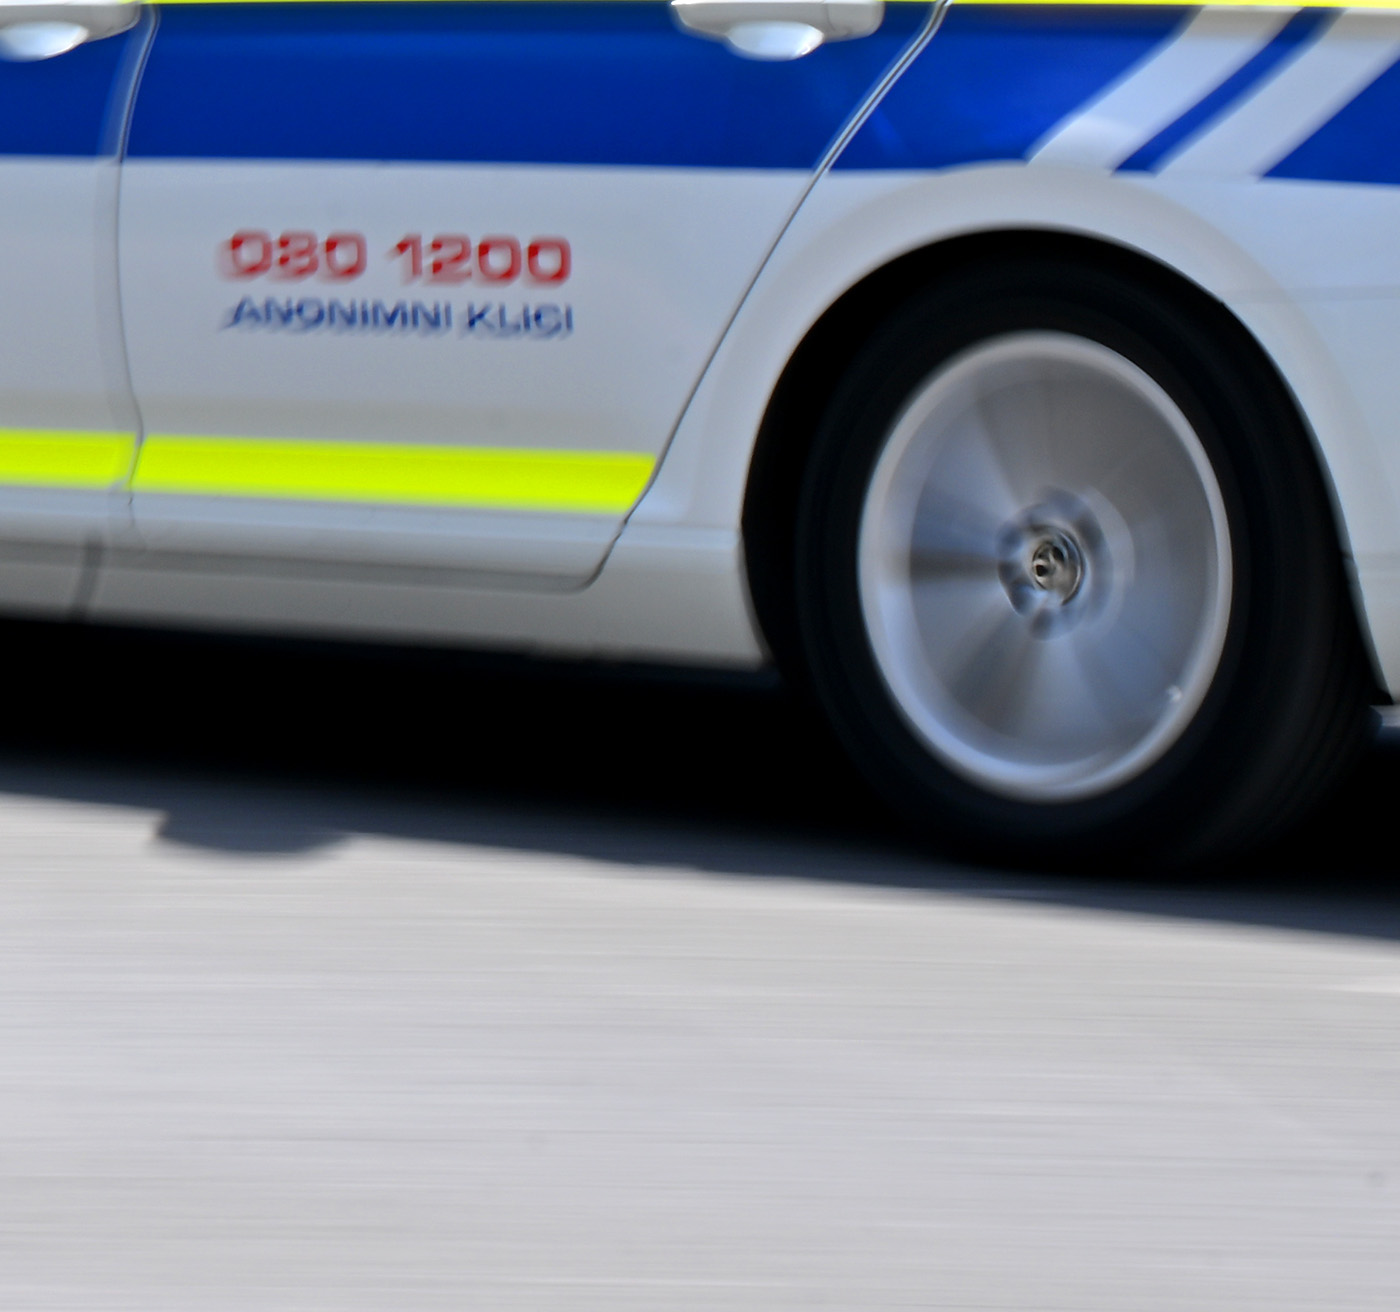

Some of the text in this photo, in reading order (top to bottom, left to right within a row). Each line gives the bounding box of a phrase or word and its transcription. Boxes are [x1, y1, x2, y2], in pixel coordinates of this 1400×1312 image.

[215, 229, 572, 288] 080 1200
[218, 295, 574, 339] ANONIMNI KLICI
